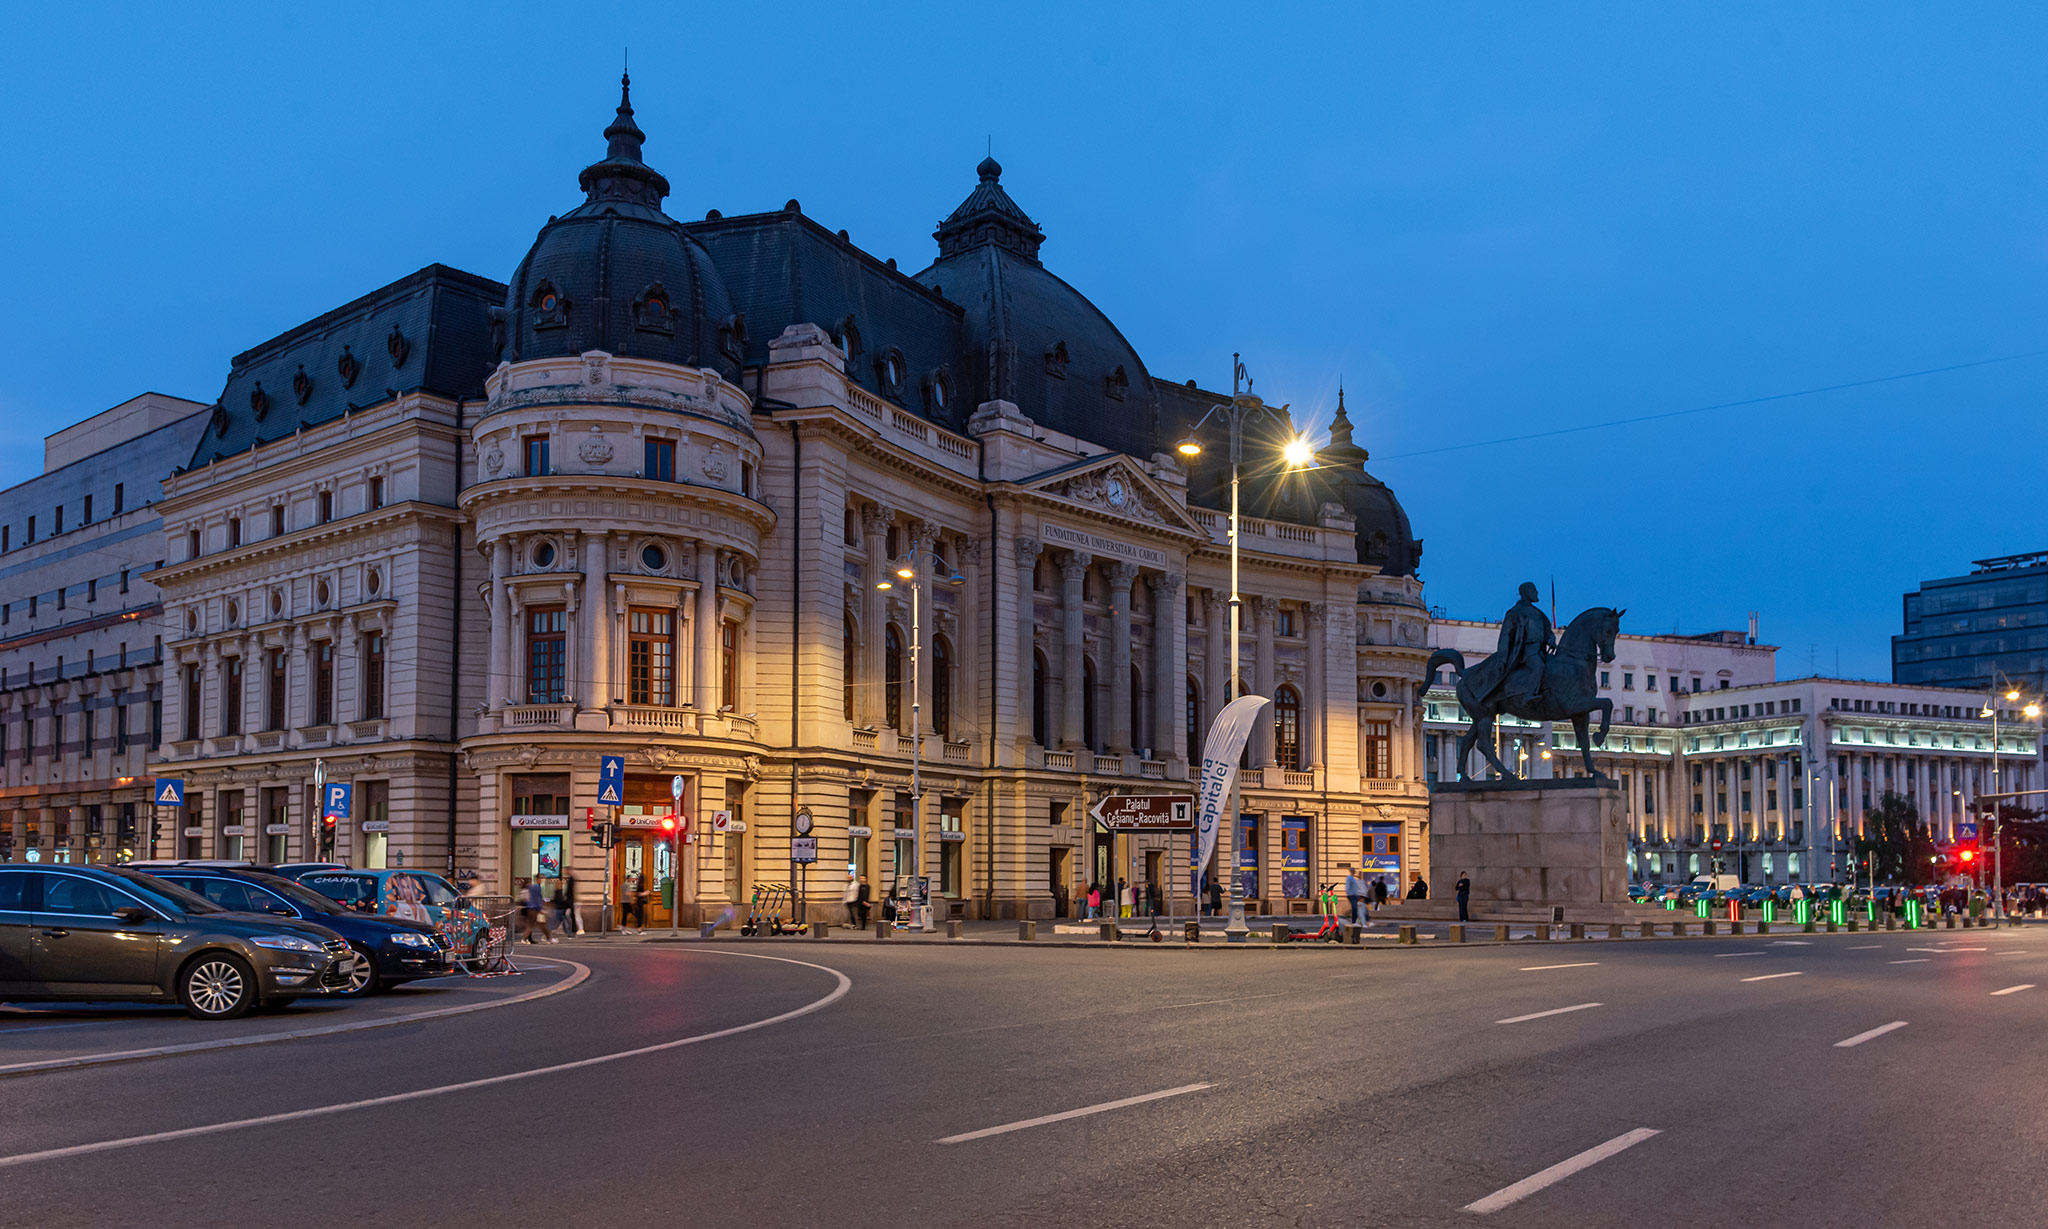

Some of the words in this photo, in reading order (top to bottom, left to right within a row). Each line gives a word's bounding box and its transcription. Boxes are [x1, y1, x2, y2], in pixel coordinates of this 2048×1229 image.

[1091, 537, 1137, 558] UNIVERSITARA
[1138, 549, 1159, 561] CAROL
[330, 787, 345, 807] P
[1125, 798, 1150, 810] Palatul
[1200, 760, 1229, 834] Capitalei
[314, 876, 360, 884] CHARM
